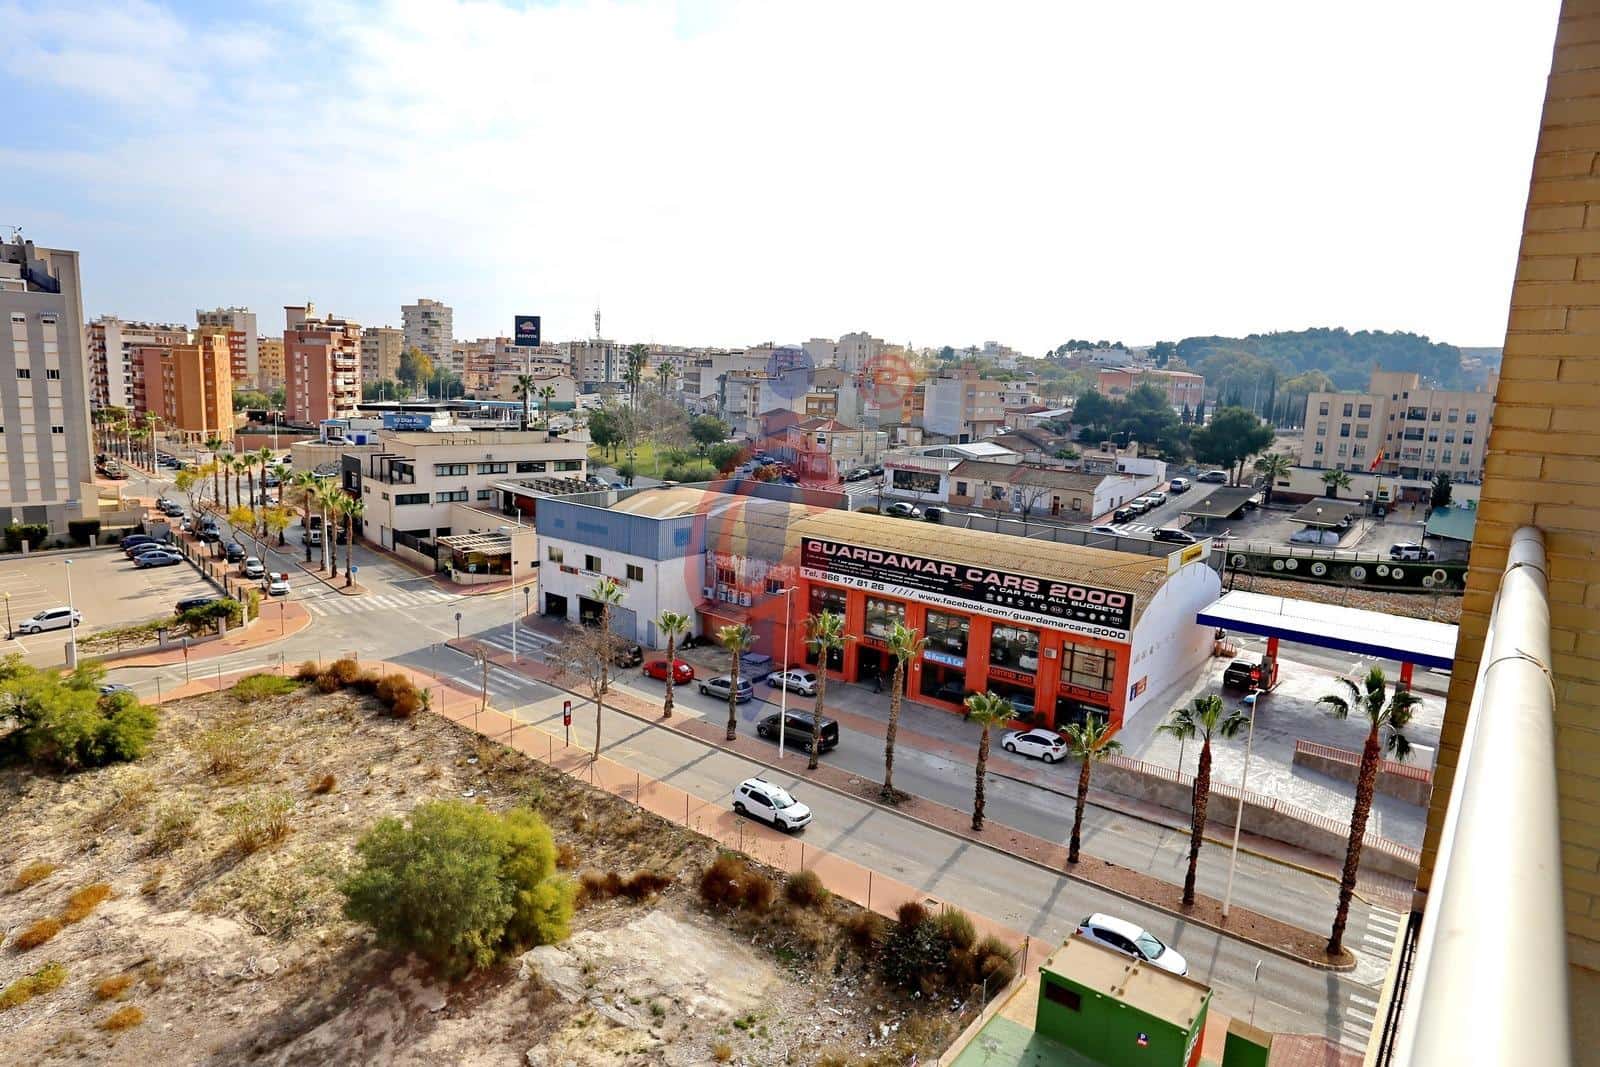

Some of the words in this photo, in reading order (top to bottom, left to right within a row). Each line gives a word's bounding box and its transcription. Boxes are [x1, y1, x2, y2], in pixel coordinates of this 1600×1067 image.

[804, 569, 819, 578] Tel.
[821, 572, 840, 582] 966
[843, 576, 854, 585] 17
[871, 582, 885, 591] 26
[918, 593, 1126, 640] www.facebook.com/guardamarcars2000
[808, 541, 957, 577] GUARDAMAR
[966, 569, 1040, 592] CARS
[1049, 583, 1126, 608] 2000
[999, 587, 1021, 596] CAR
[1024, 592, 1045, 600] FOR
[1048, 597, 1068, 605] ALL
[1071, 601, 1124, 615] BUDGETS
